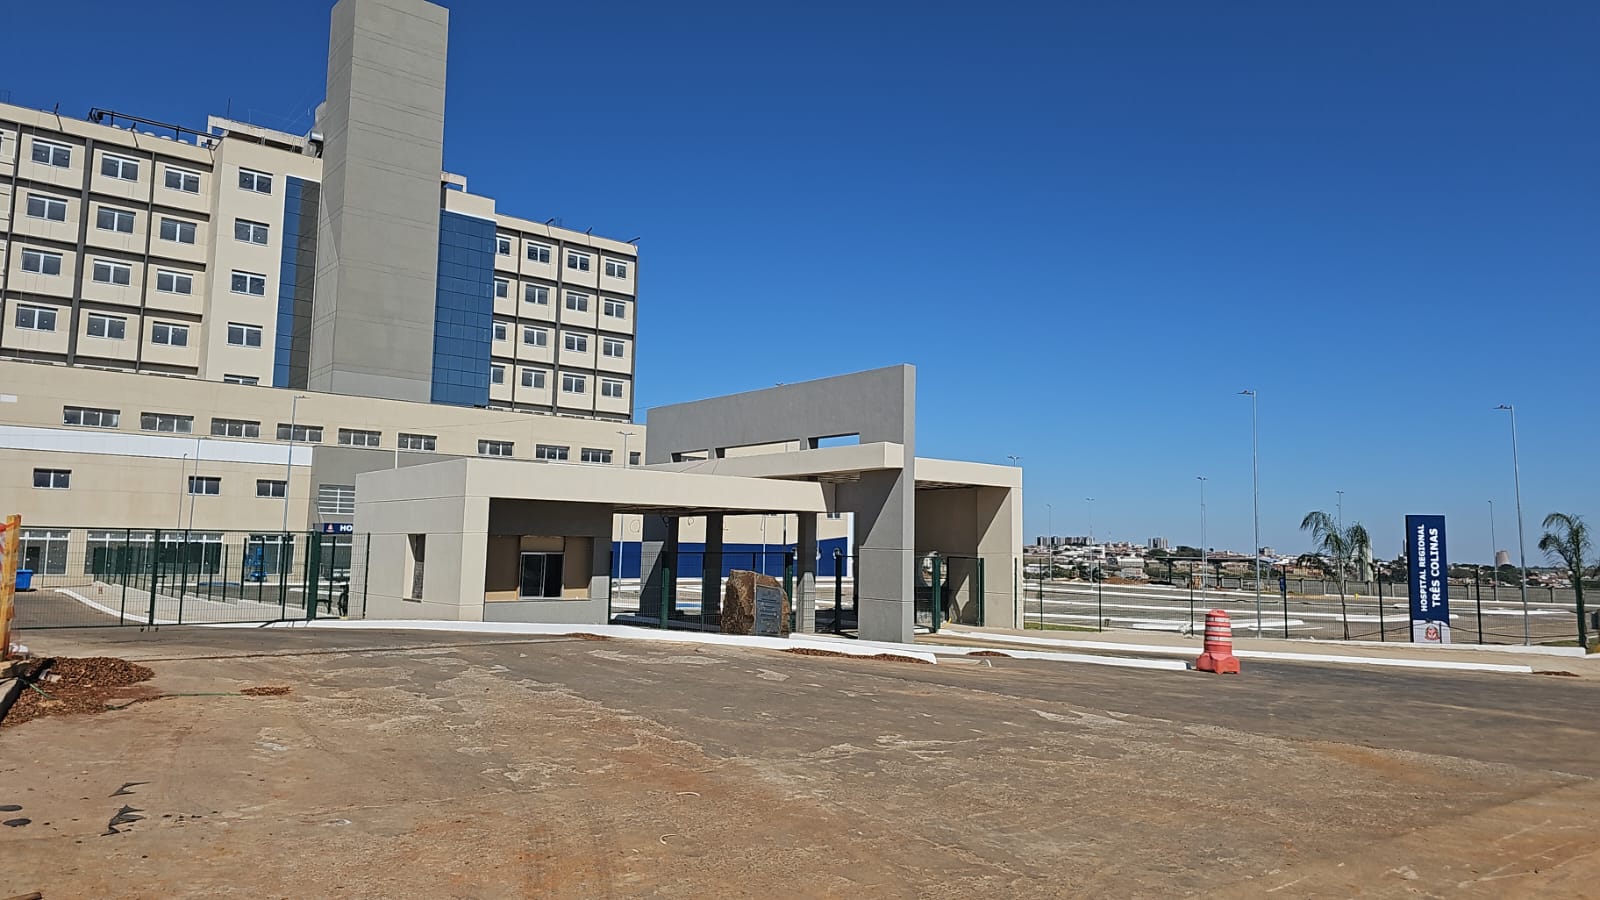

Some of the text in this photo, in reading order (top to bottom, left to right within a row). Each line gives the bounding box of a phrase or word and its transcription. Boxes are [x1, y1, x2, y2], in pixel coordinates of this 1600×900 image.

[1417, 524, 1428, 612] HOSPITAL REGIONAL
[1429, 528, 1440, 607] TRÊS COLINAS
